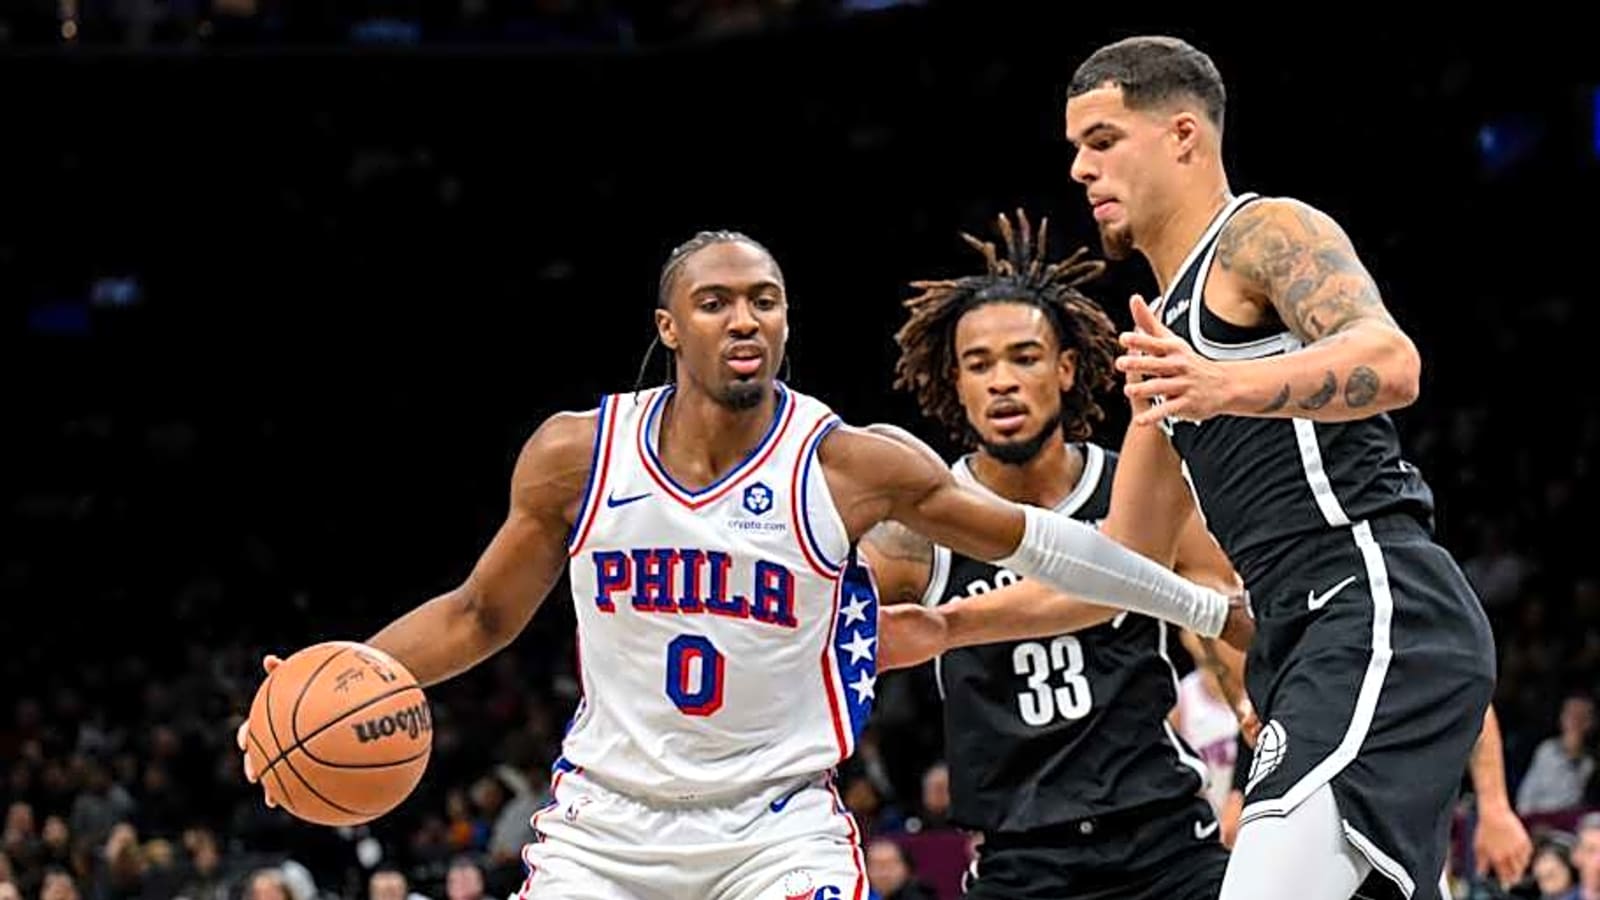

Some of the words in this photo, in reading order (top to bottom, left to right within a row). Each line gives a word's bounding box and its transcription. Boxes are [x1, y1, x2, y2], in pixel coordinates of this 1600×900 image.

[727, 519, 787, 531] crypto.com
[593, 549, 798, 628] PHILA
[665, 633, 724, 717] 0
[1012, 635, 1093, 727] 33
